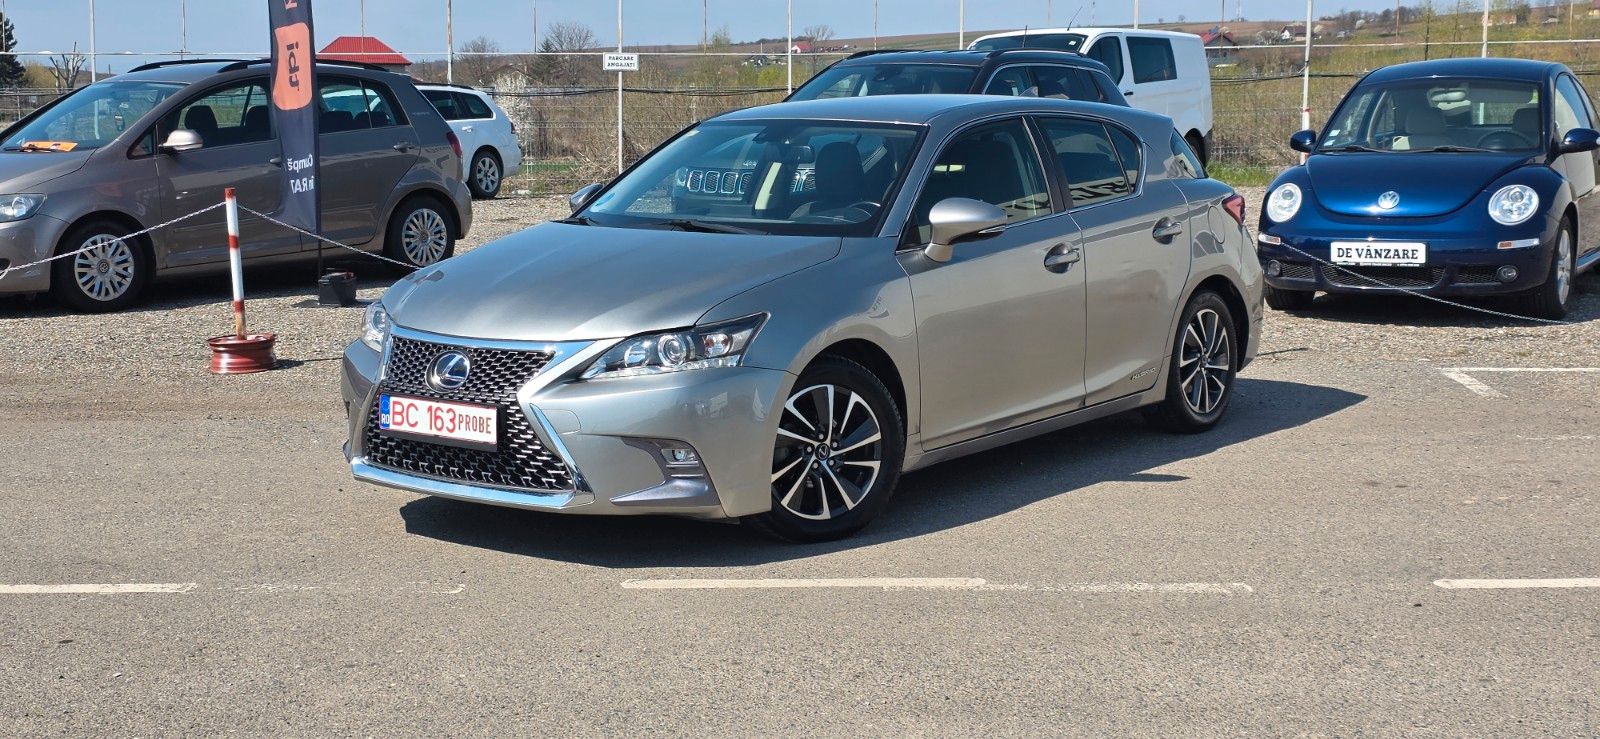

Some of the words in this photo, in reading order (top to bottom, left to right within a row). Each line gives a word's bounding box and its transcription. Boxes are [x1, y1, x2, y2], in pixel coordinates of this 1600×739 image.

[1337, 248, 1352, 258] DE
[1355, 245, 1419, 260] VÂNZARE
[382, 413, 390, 425] RO
[392, 400, 419, 428] BC
[427, 405, 457, 433] 163
[458, 413, 492, 434] PROBE
